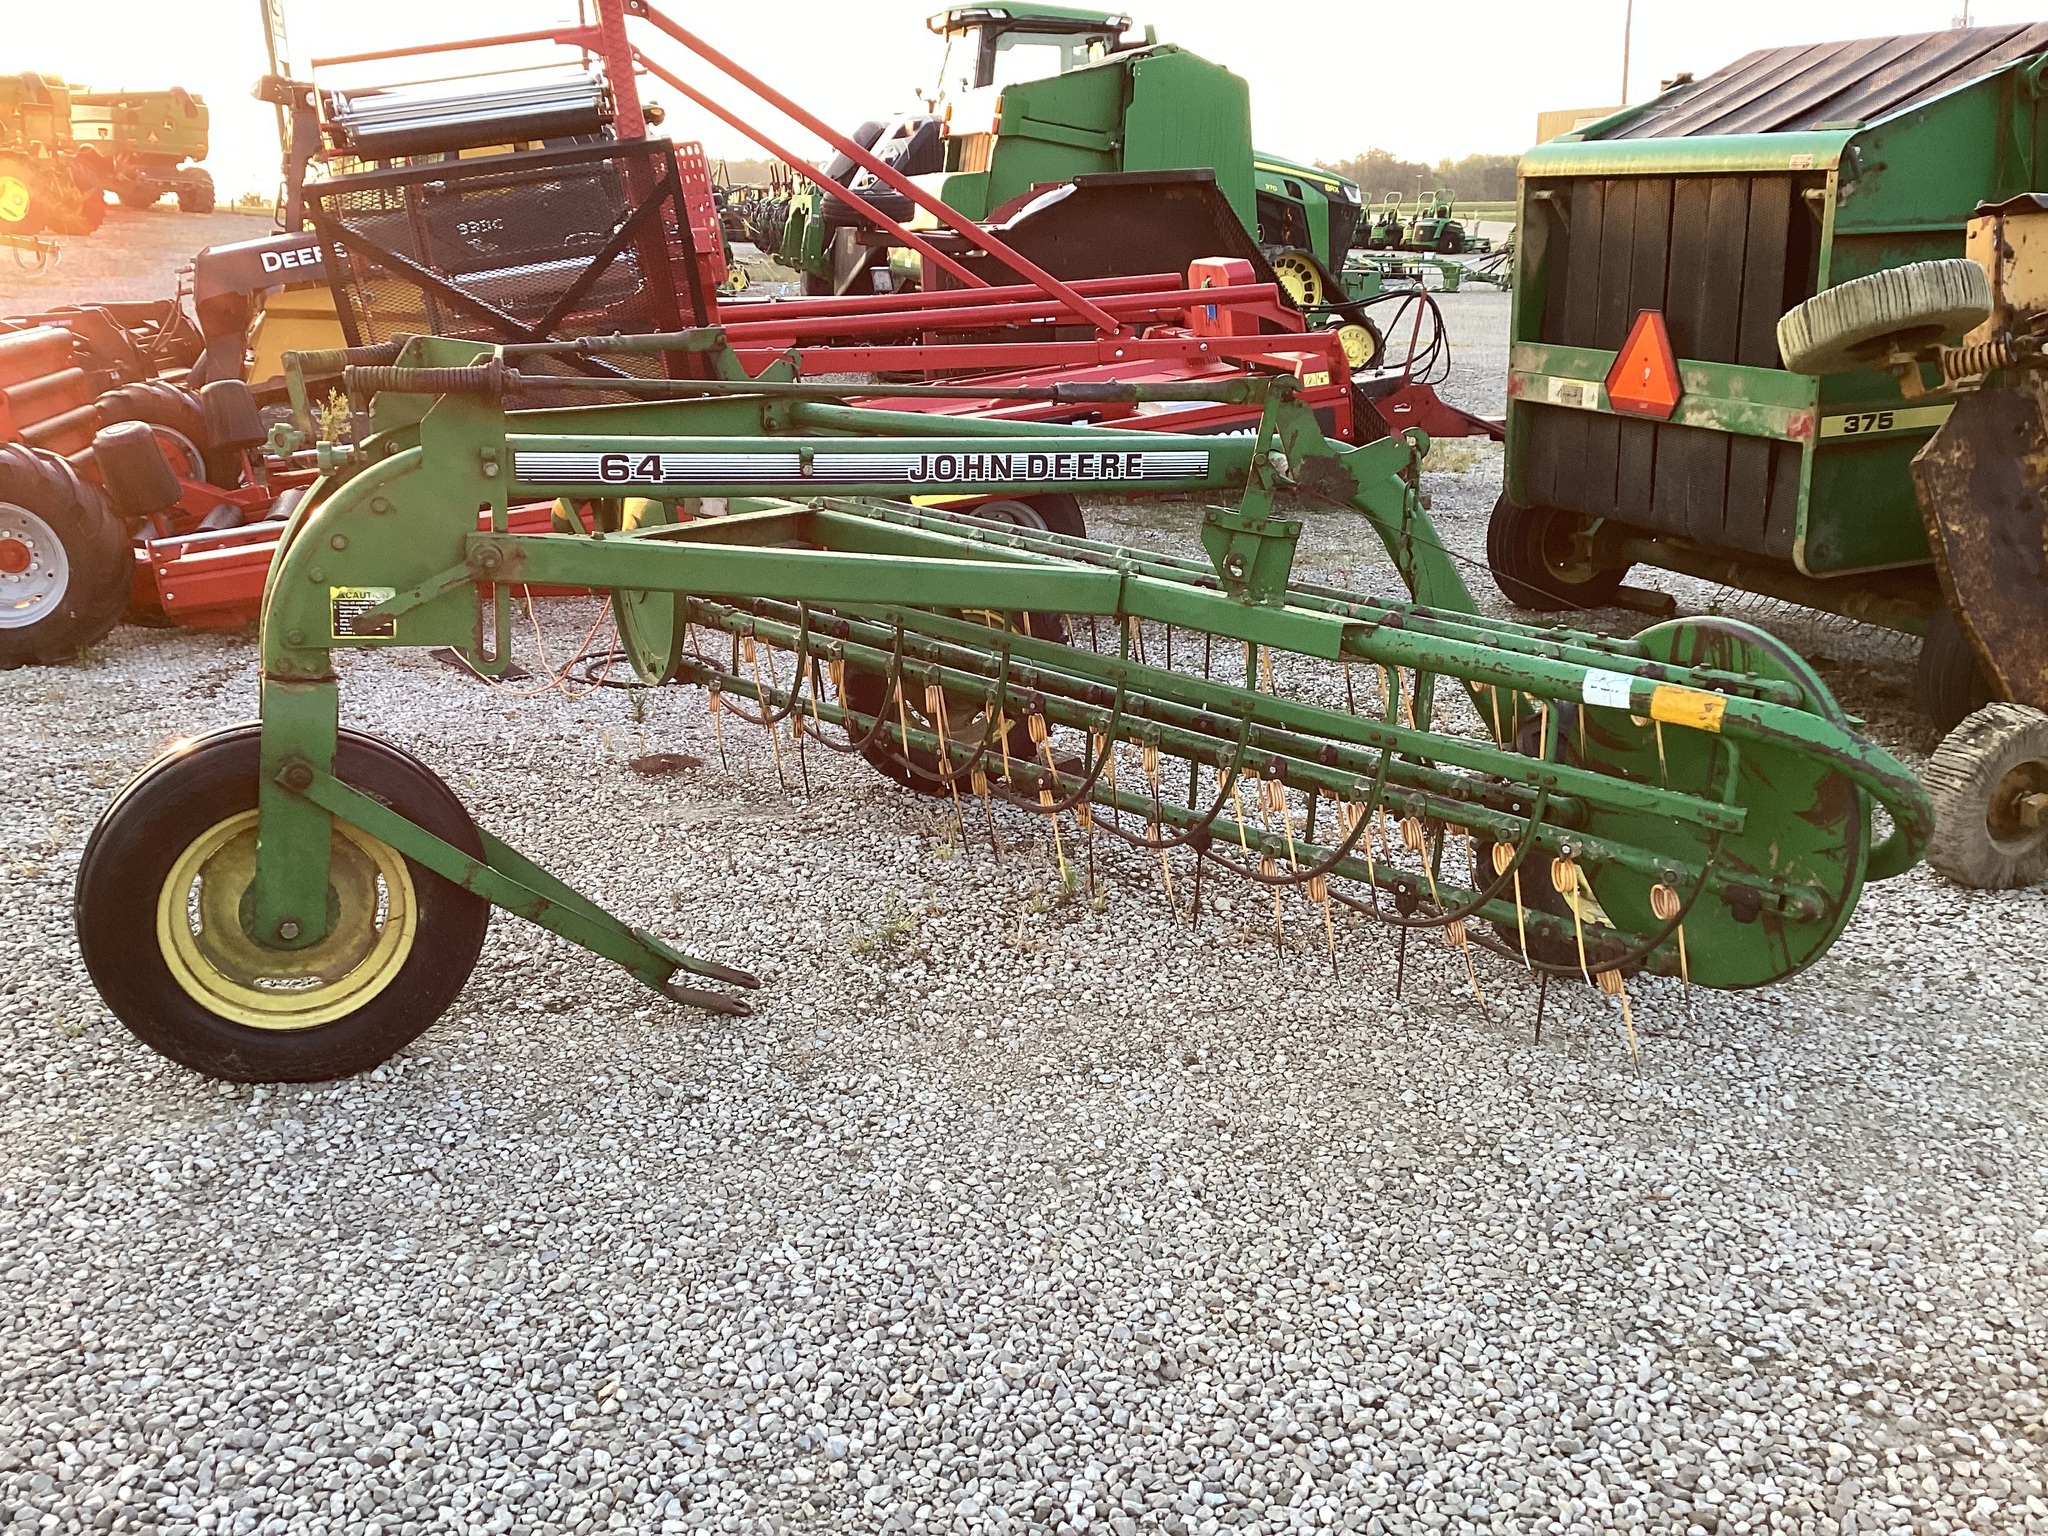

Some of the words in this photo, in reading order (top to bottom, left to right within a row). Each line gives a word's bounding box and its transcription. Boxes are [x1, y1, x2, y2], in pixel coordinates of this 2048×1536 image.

[1844, 412, 1894, 434] 375
[599, 453, 665, 484] 64
[908, 453, 1014, 483] JOHN
[1025, 452, 1144, 481] DEERE
